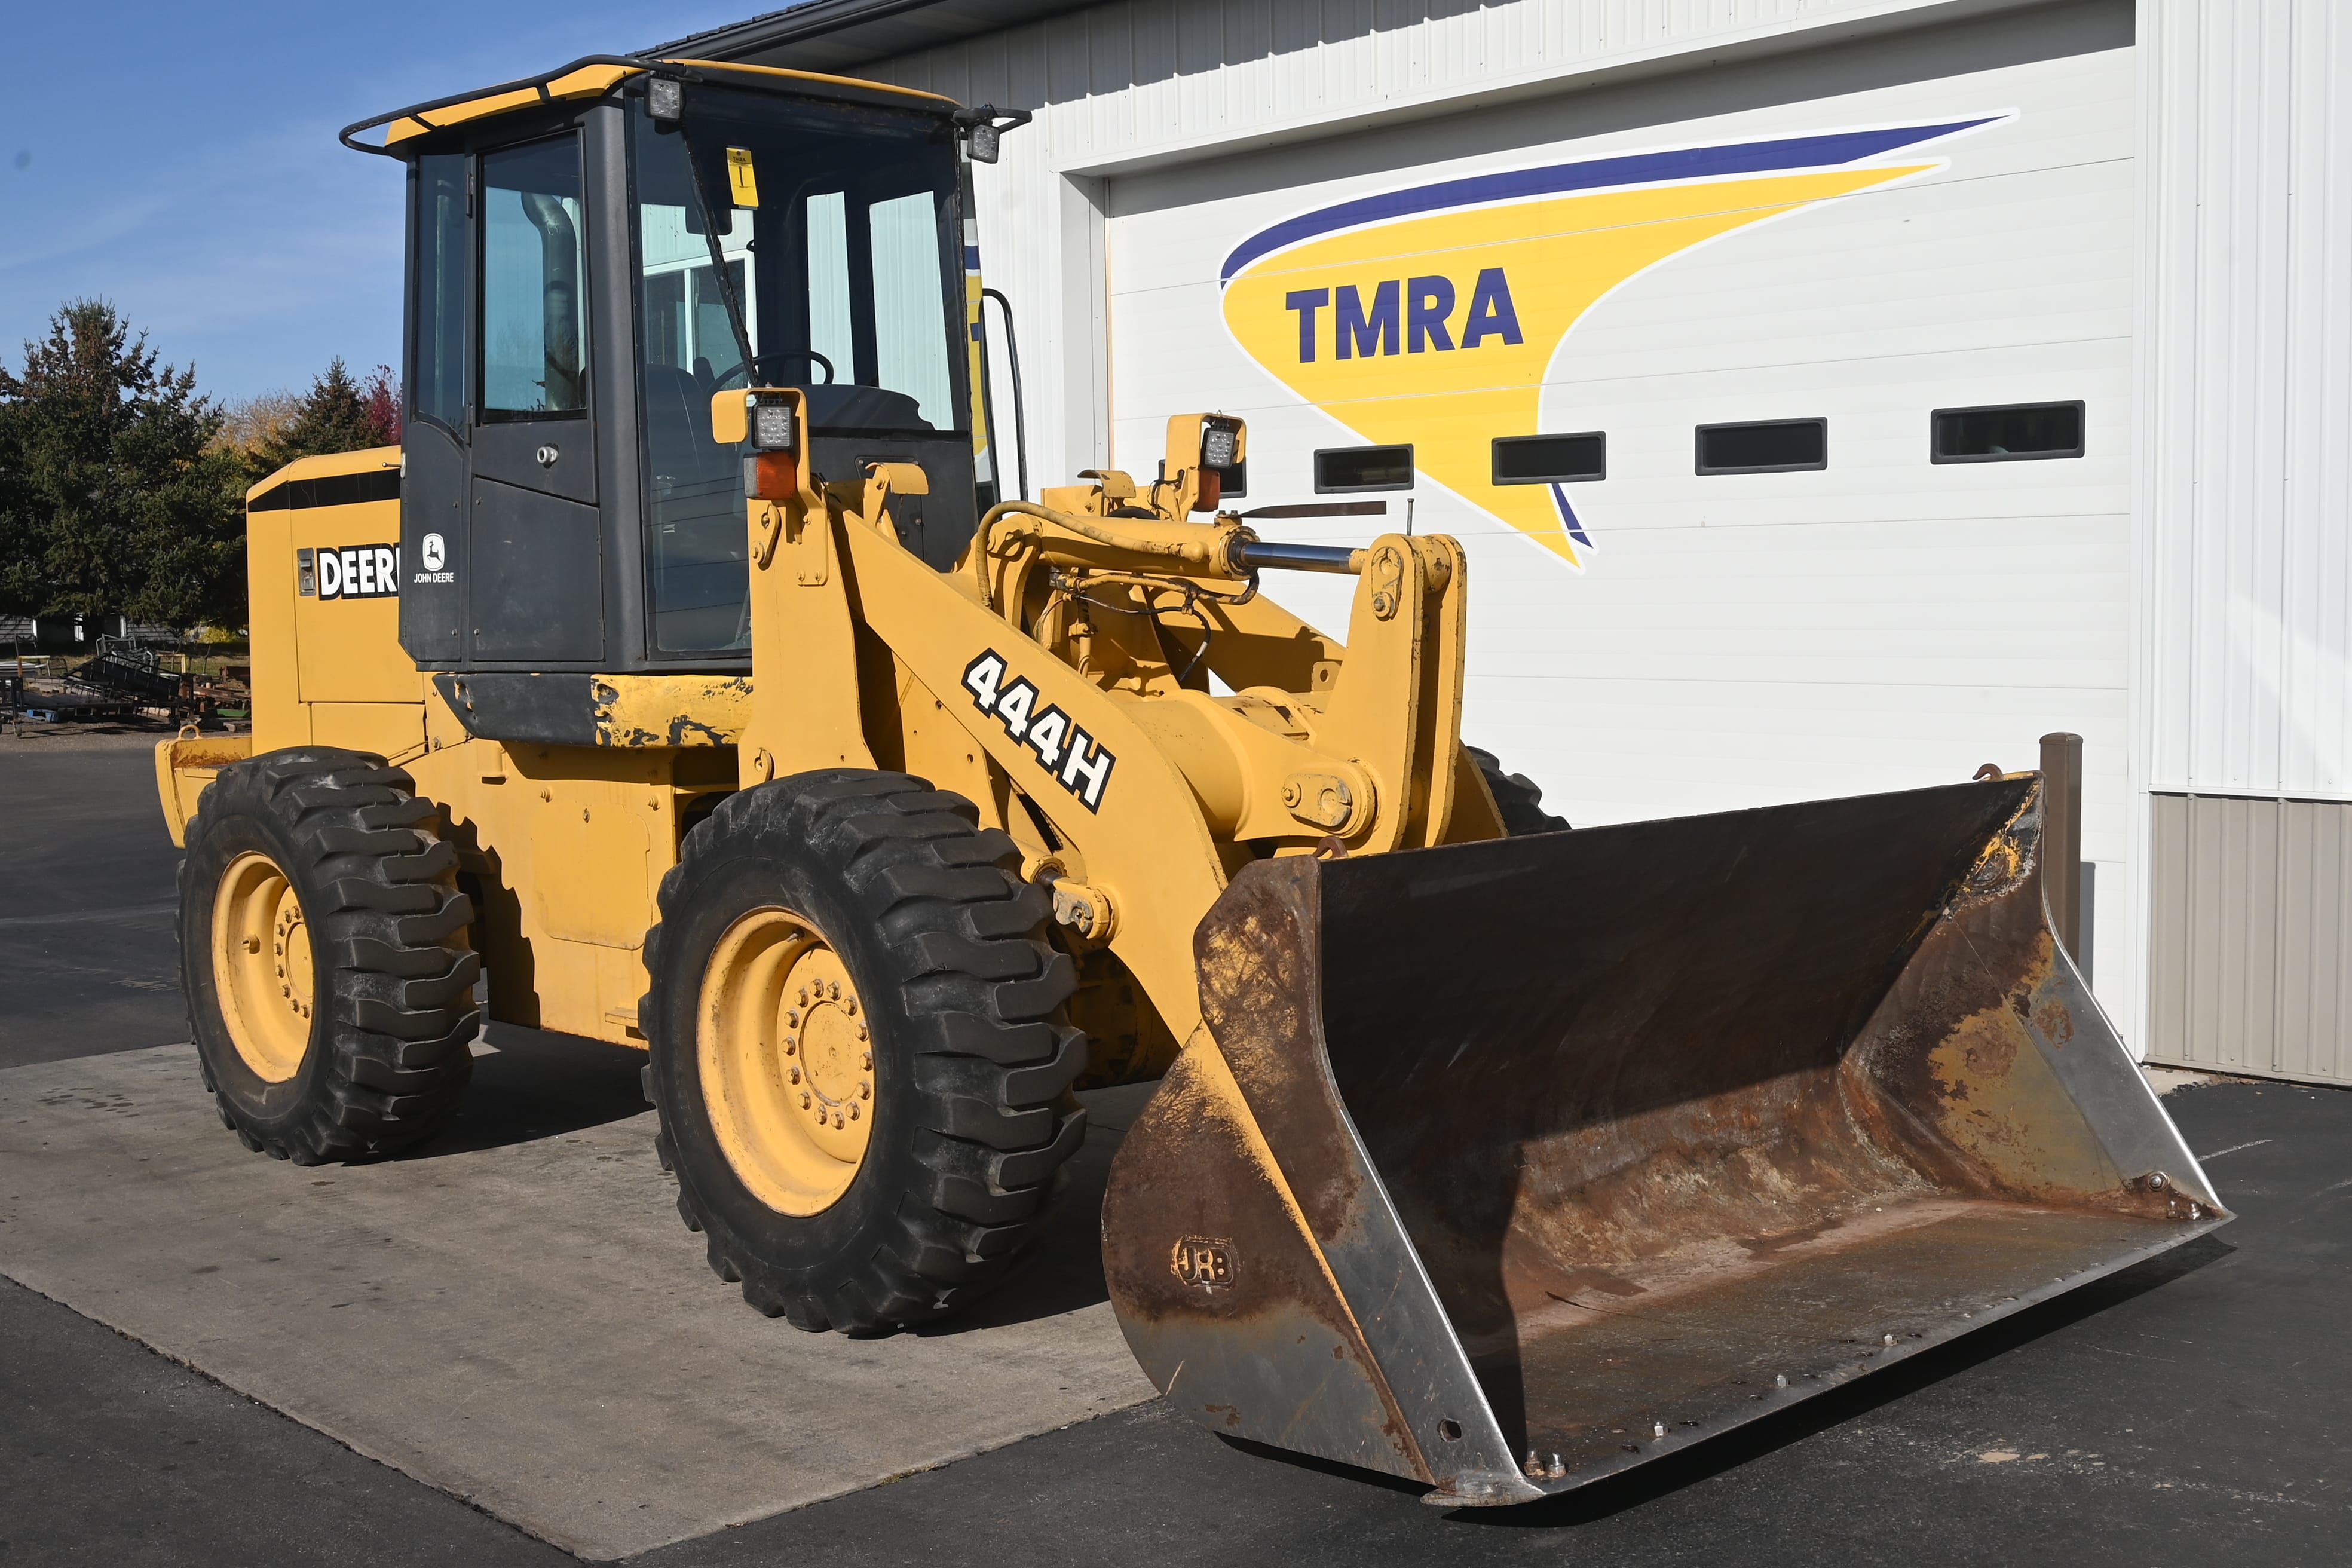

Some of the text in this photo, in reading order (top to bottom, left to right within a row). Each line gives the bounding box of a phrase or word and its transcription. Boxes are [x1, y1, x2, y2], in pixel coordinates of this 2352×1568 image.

[1286, 267, 1523, 363] TMRA
[319, 547, 400, 595] DEER
[414, 572, 454, 584] JOHN DEERE
[967, 656, 1110, 806] 444H
[1178, 1245, 1233, 1283] JRB
